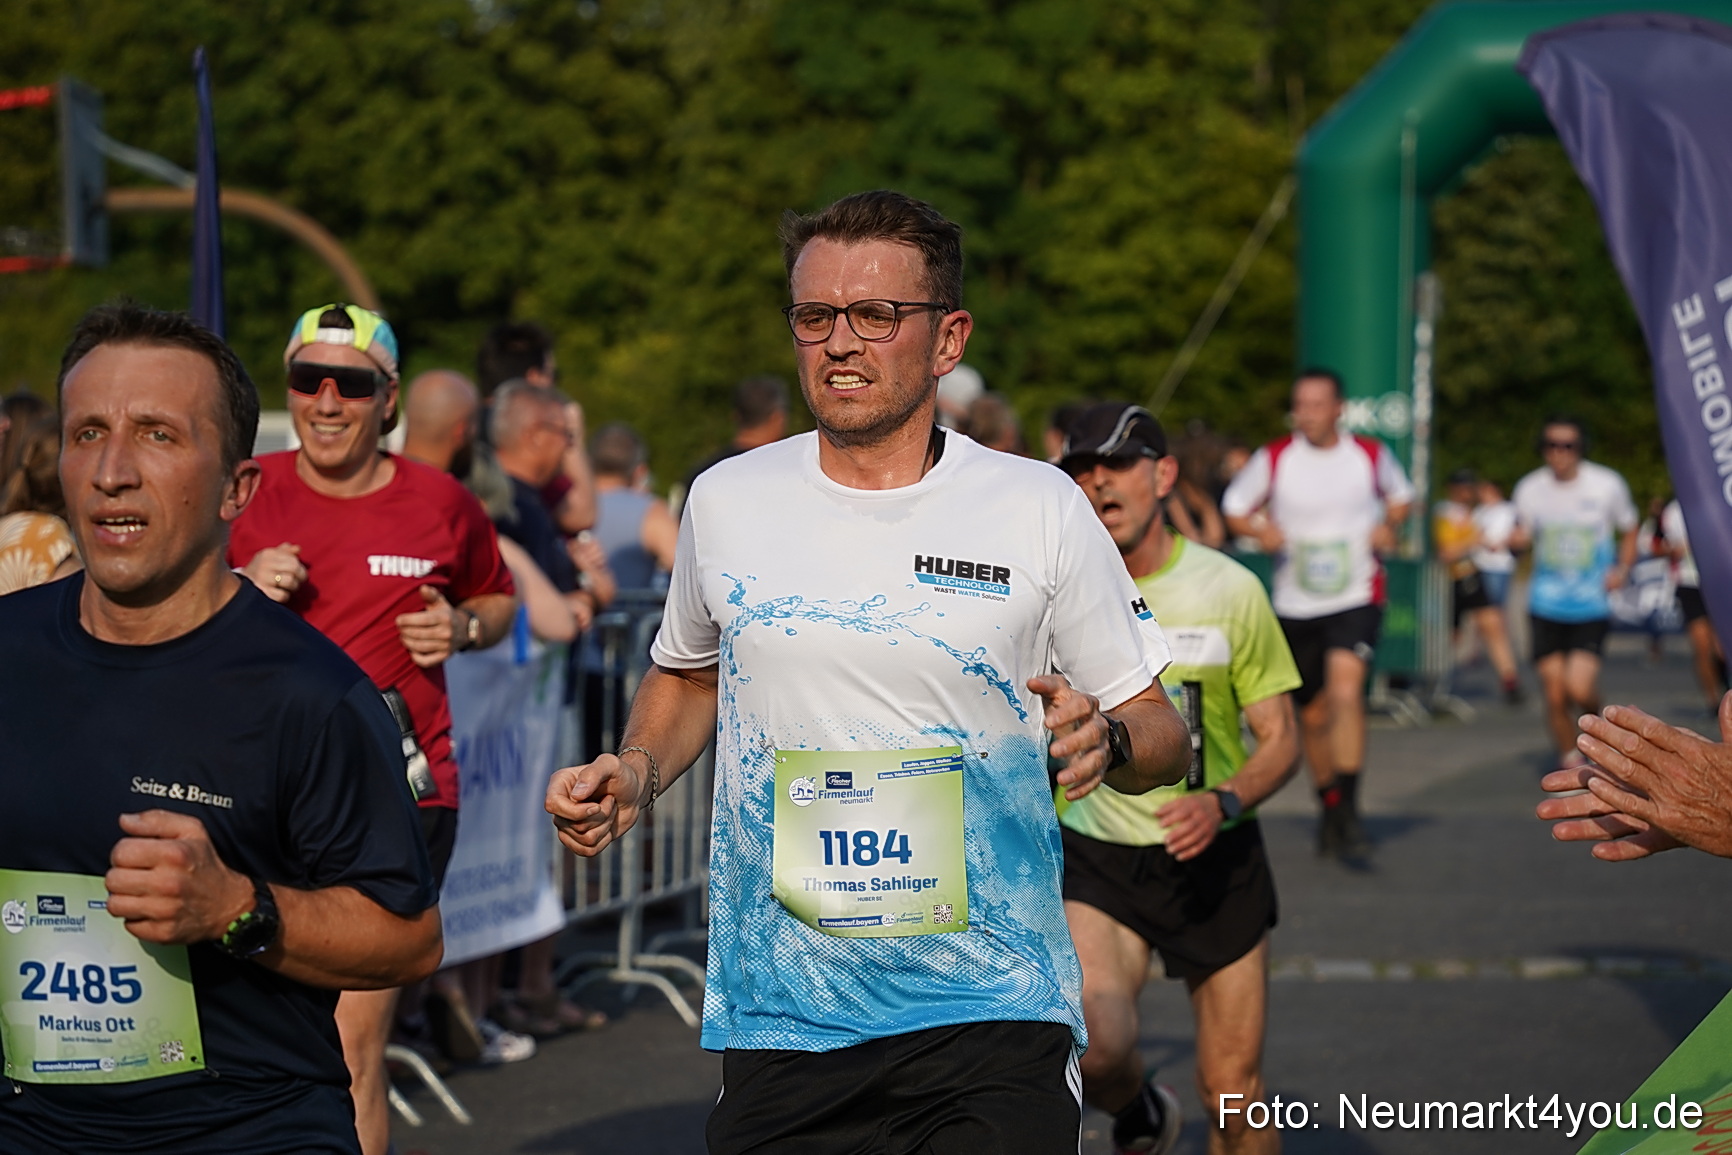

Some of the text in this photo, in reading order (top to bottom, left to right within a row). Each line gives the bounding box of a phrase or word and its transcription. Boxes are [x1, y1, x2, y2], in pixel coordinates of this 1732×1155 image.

[1671, 291, 1732, 507] MOBILE
[914, 554, 1011, 586] HUBER
[934, 576, 1007, 594] TECHNOLOGY
[934, 586, 1006, 603] WASTE WATER Solutions
[130, 776, 234, 809] Seitz & Braun
[818, 787, 874, 800] Firmenlauf
[839, 797, 873, 805] neumarkt
[819, 829, 912, 867] 1184
[802, 875, 938, 893] Thomas Sahliger
[29, 915, 86, 927] Firmenlauf
[53, 926, 86, 934] neumarkt
[821, 918, 879, 927] firmenlauf.bayern
[19, 960, 142, 1005] 2485
[39, 1015, 136, 1033] Markus Ott
[35, 1062, 98, 1071] firmenlauf.bayern
